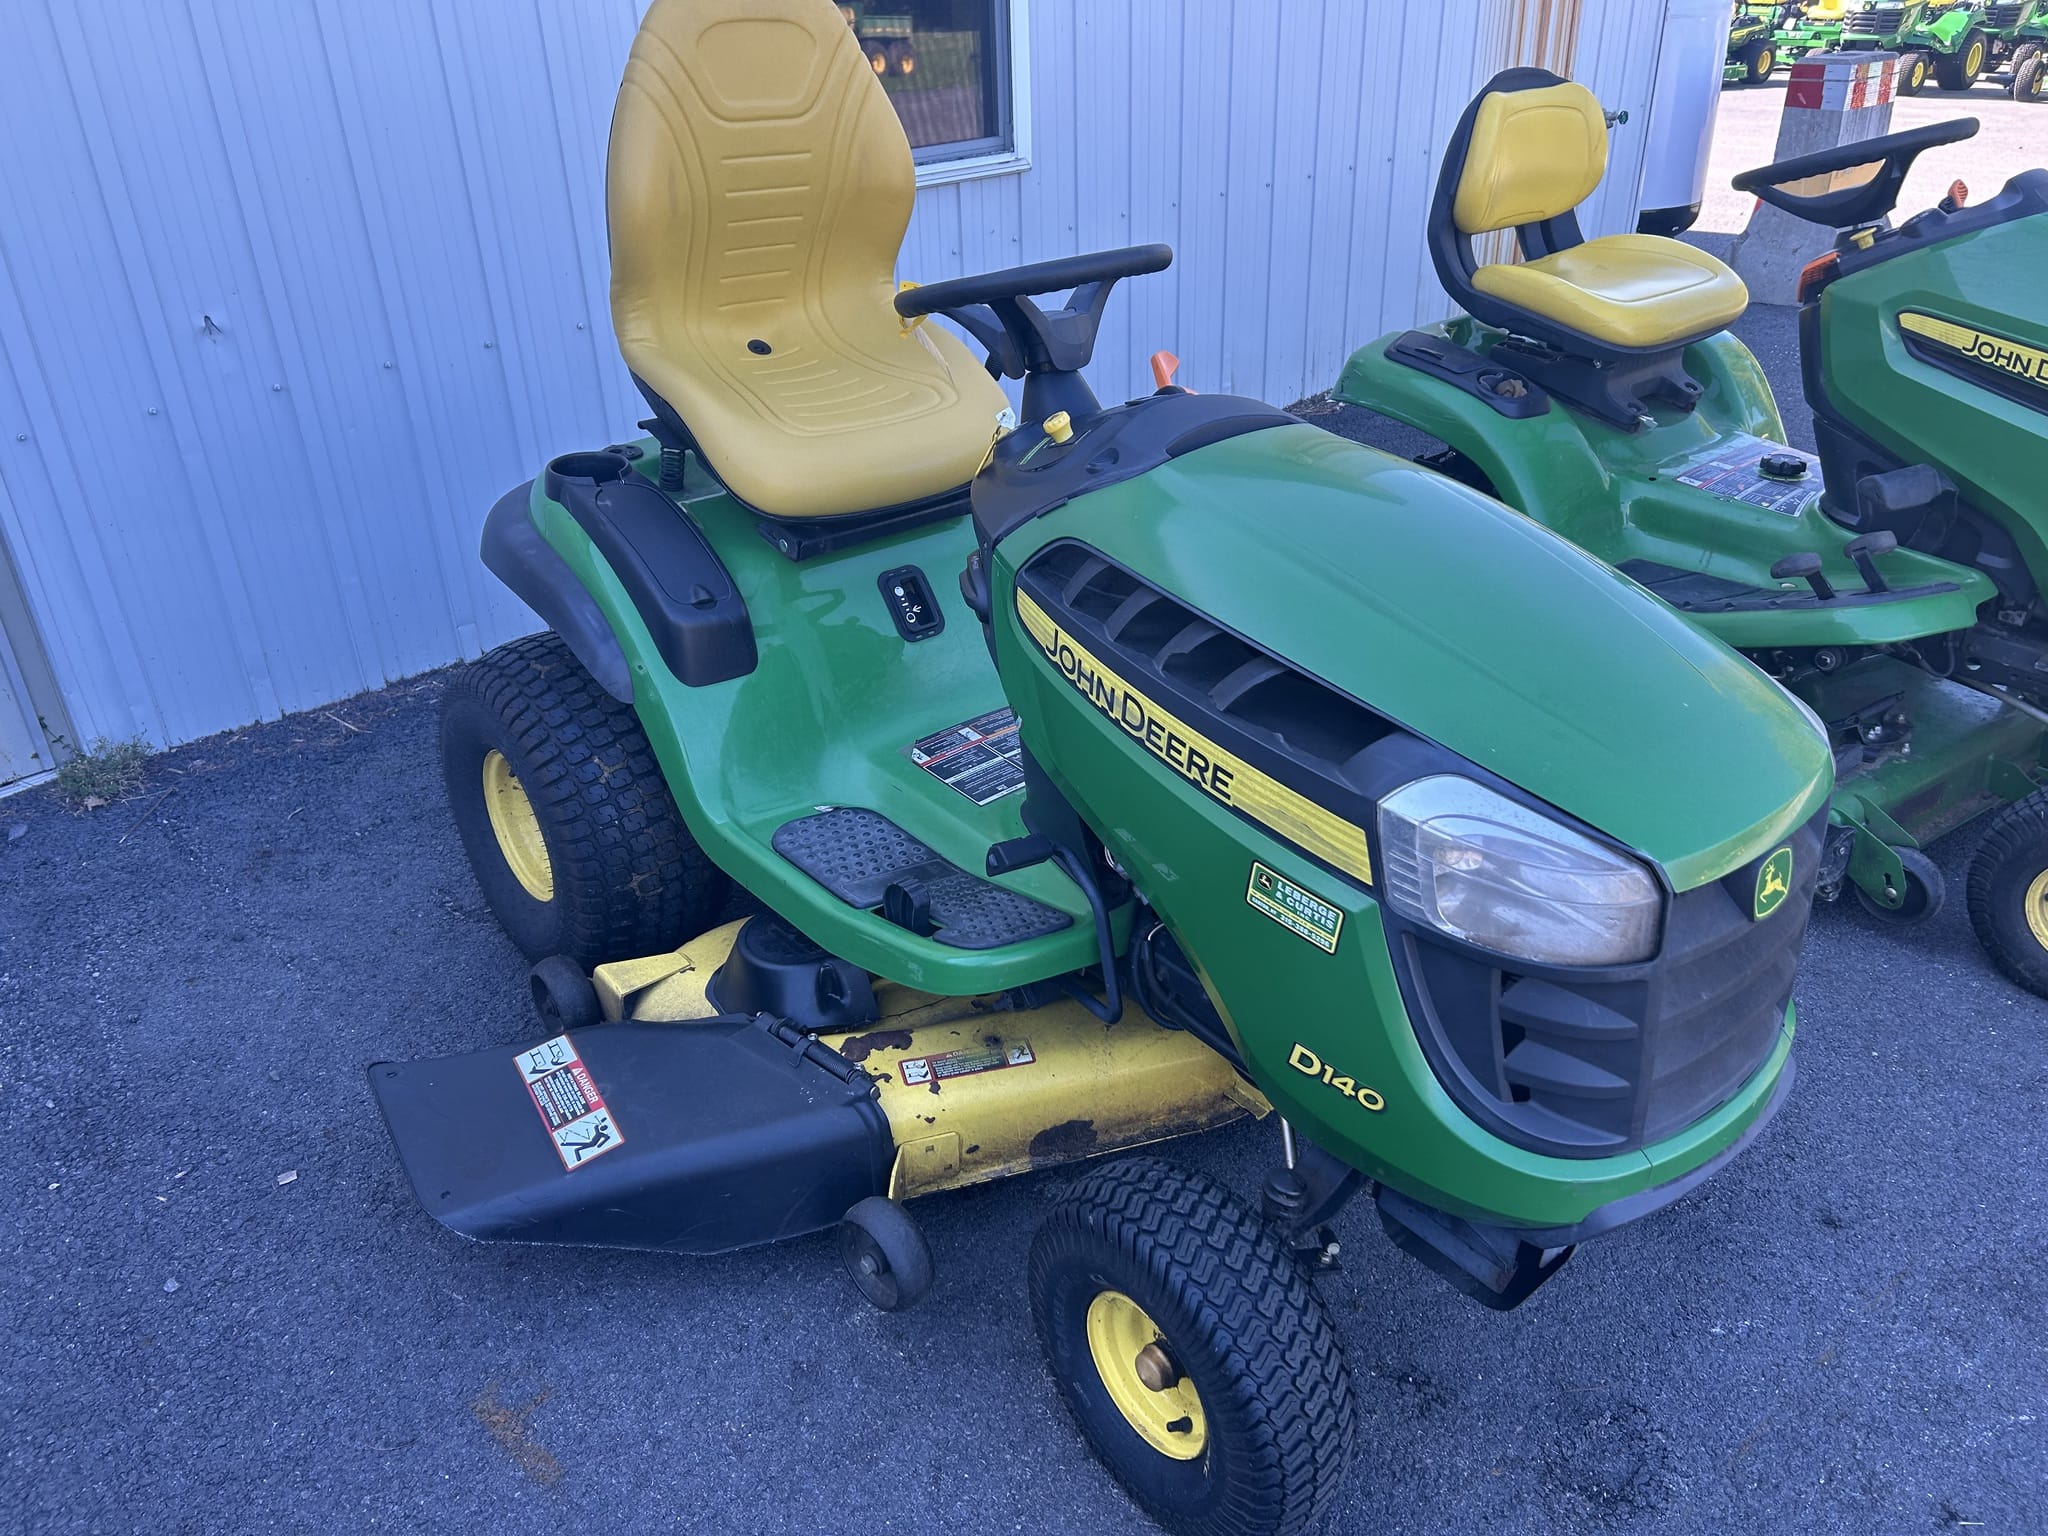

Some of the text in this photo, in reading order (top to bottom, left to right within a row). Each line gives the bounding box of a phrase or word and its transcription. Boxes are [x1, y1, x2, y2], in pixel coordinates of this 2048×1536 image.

[1962, 334, 2032, 375] JOHN
[1045, 628, 1116, 714] JOHN
[1120, 690, 1235, 801] DEERE
[1275, 891, 1283, 901] &
[1286, 896, 1335, 930] CURTIS
[1277, 880, 1337, 922] LEBERGE
[577, 1072, 599, 1105] DANGER
[1288, 1043, 1385, 1112] D140
